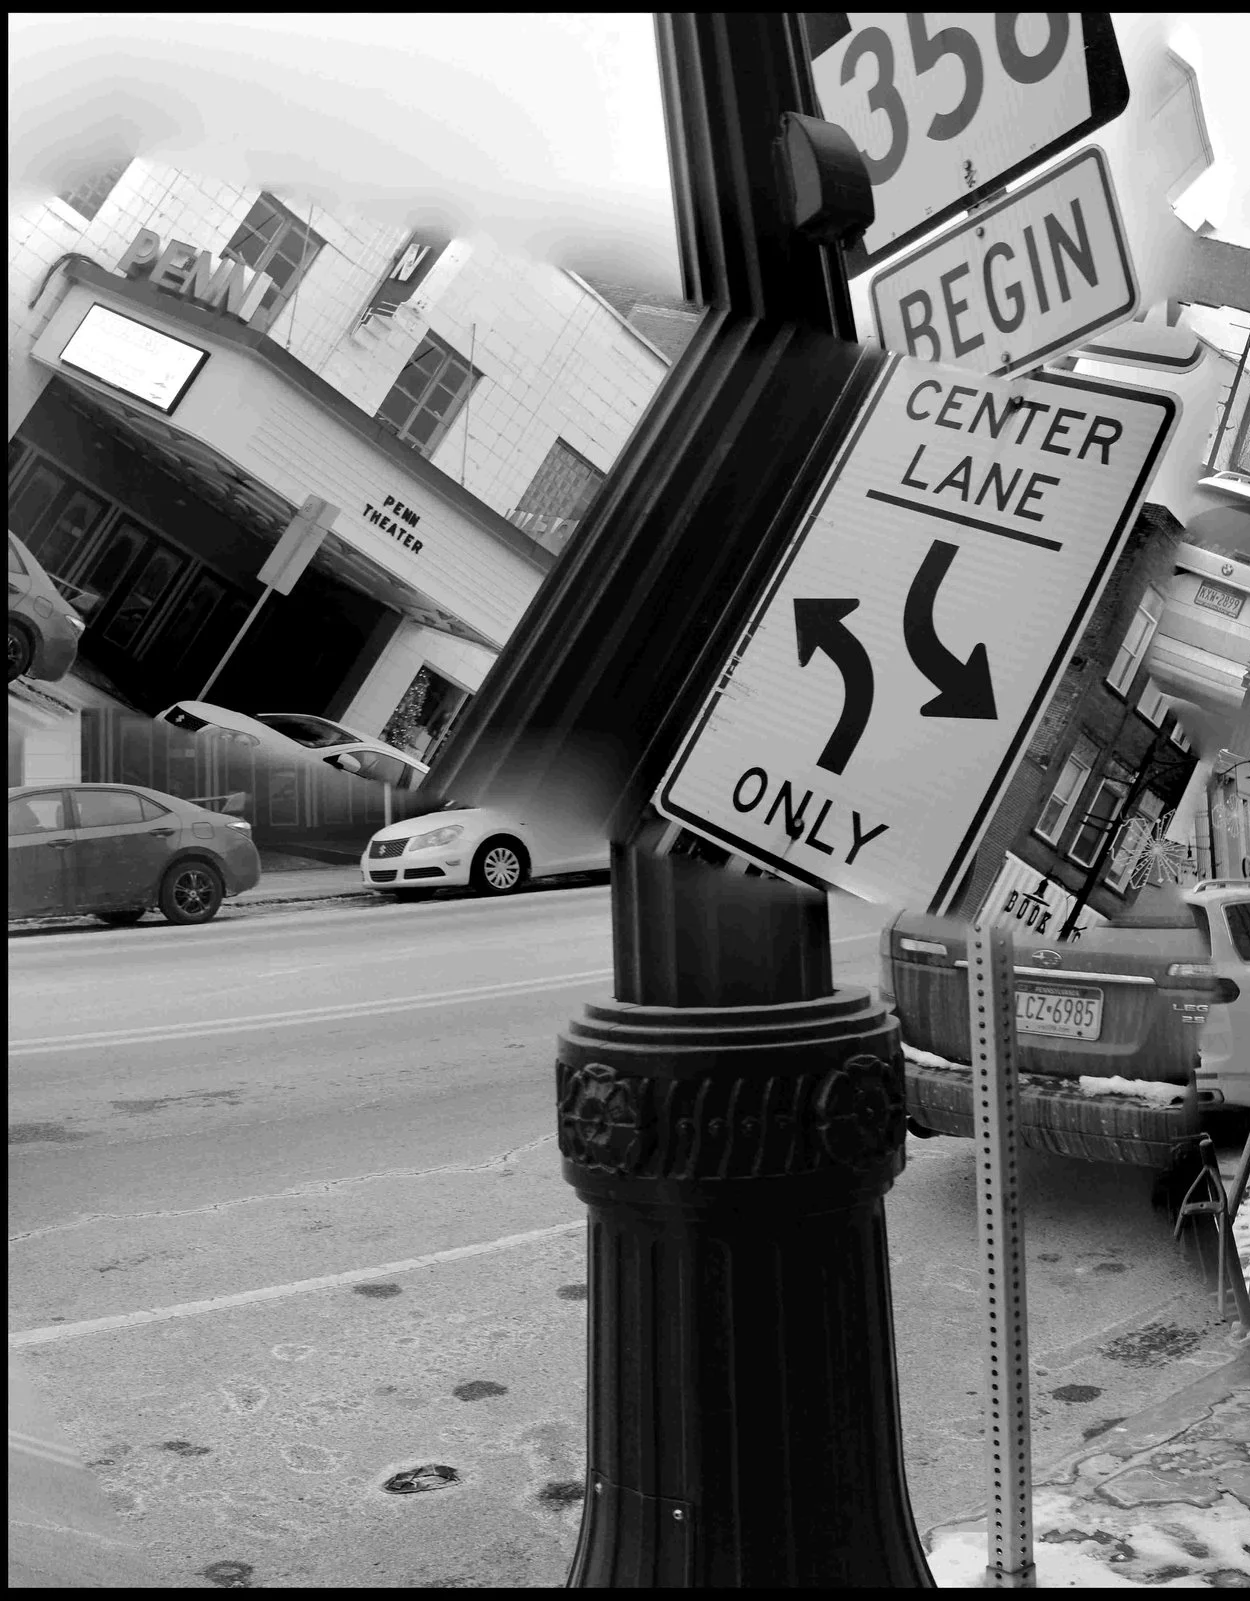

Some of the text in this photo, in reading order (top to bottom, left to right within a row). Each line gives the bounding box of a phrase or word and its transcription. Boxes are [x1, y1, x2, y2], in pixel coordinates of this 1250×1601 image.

[117, 227, 273, 323] PENN
[900, 198, 1099, 363] BEGIN
[906, 379, 1124, 465] CENTER
[383, 494, 421, 528] PENN
[900, 444, 1061, 523] LANE
[363, 503, 423, 554] THEATER
[731, 766, 890, 866] ONLY
[1003, 889, 1053, 935] BOOK
